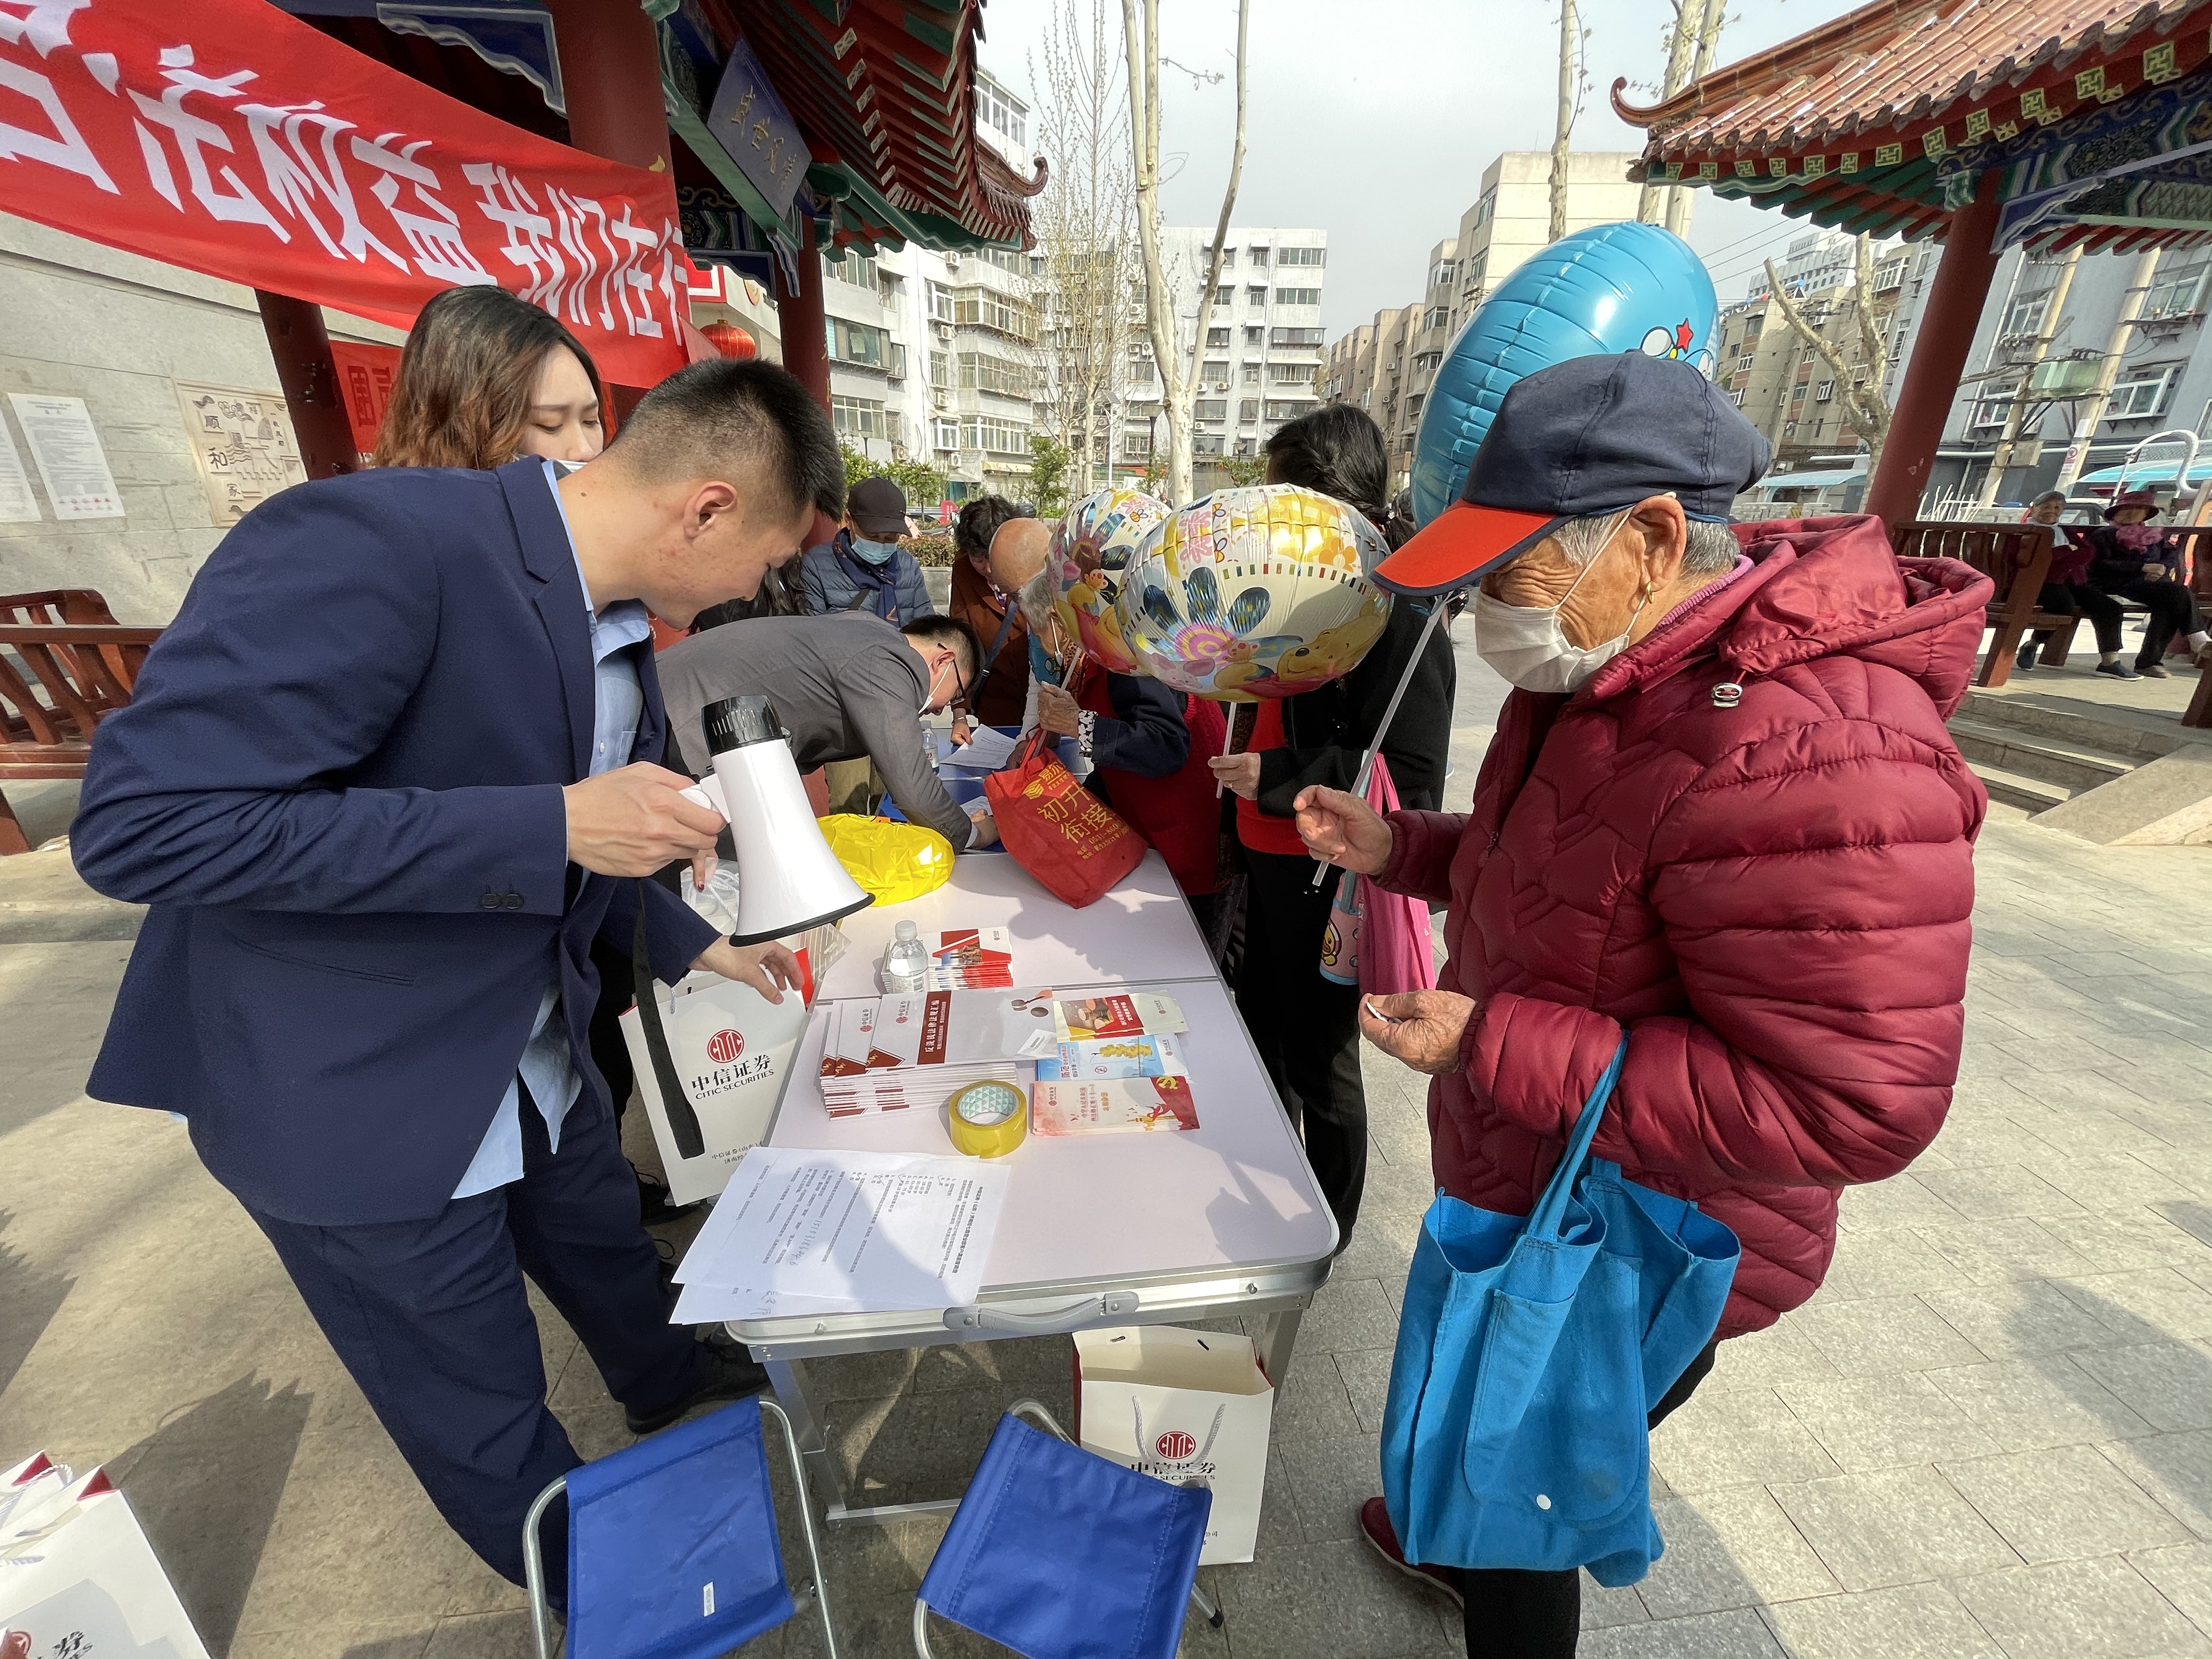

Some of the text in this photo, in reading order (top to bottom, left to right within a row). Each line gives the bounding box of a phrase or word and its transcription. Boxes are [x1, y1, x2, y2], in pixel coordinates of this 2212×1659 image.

[208, 447, 228, 470] 和
[1036, 781, 1091, 822] 初升
[692, 1054, 771, 1091] 中信证券
[696, 1069, 774, 1099] CITIC SECURITIES
